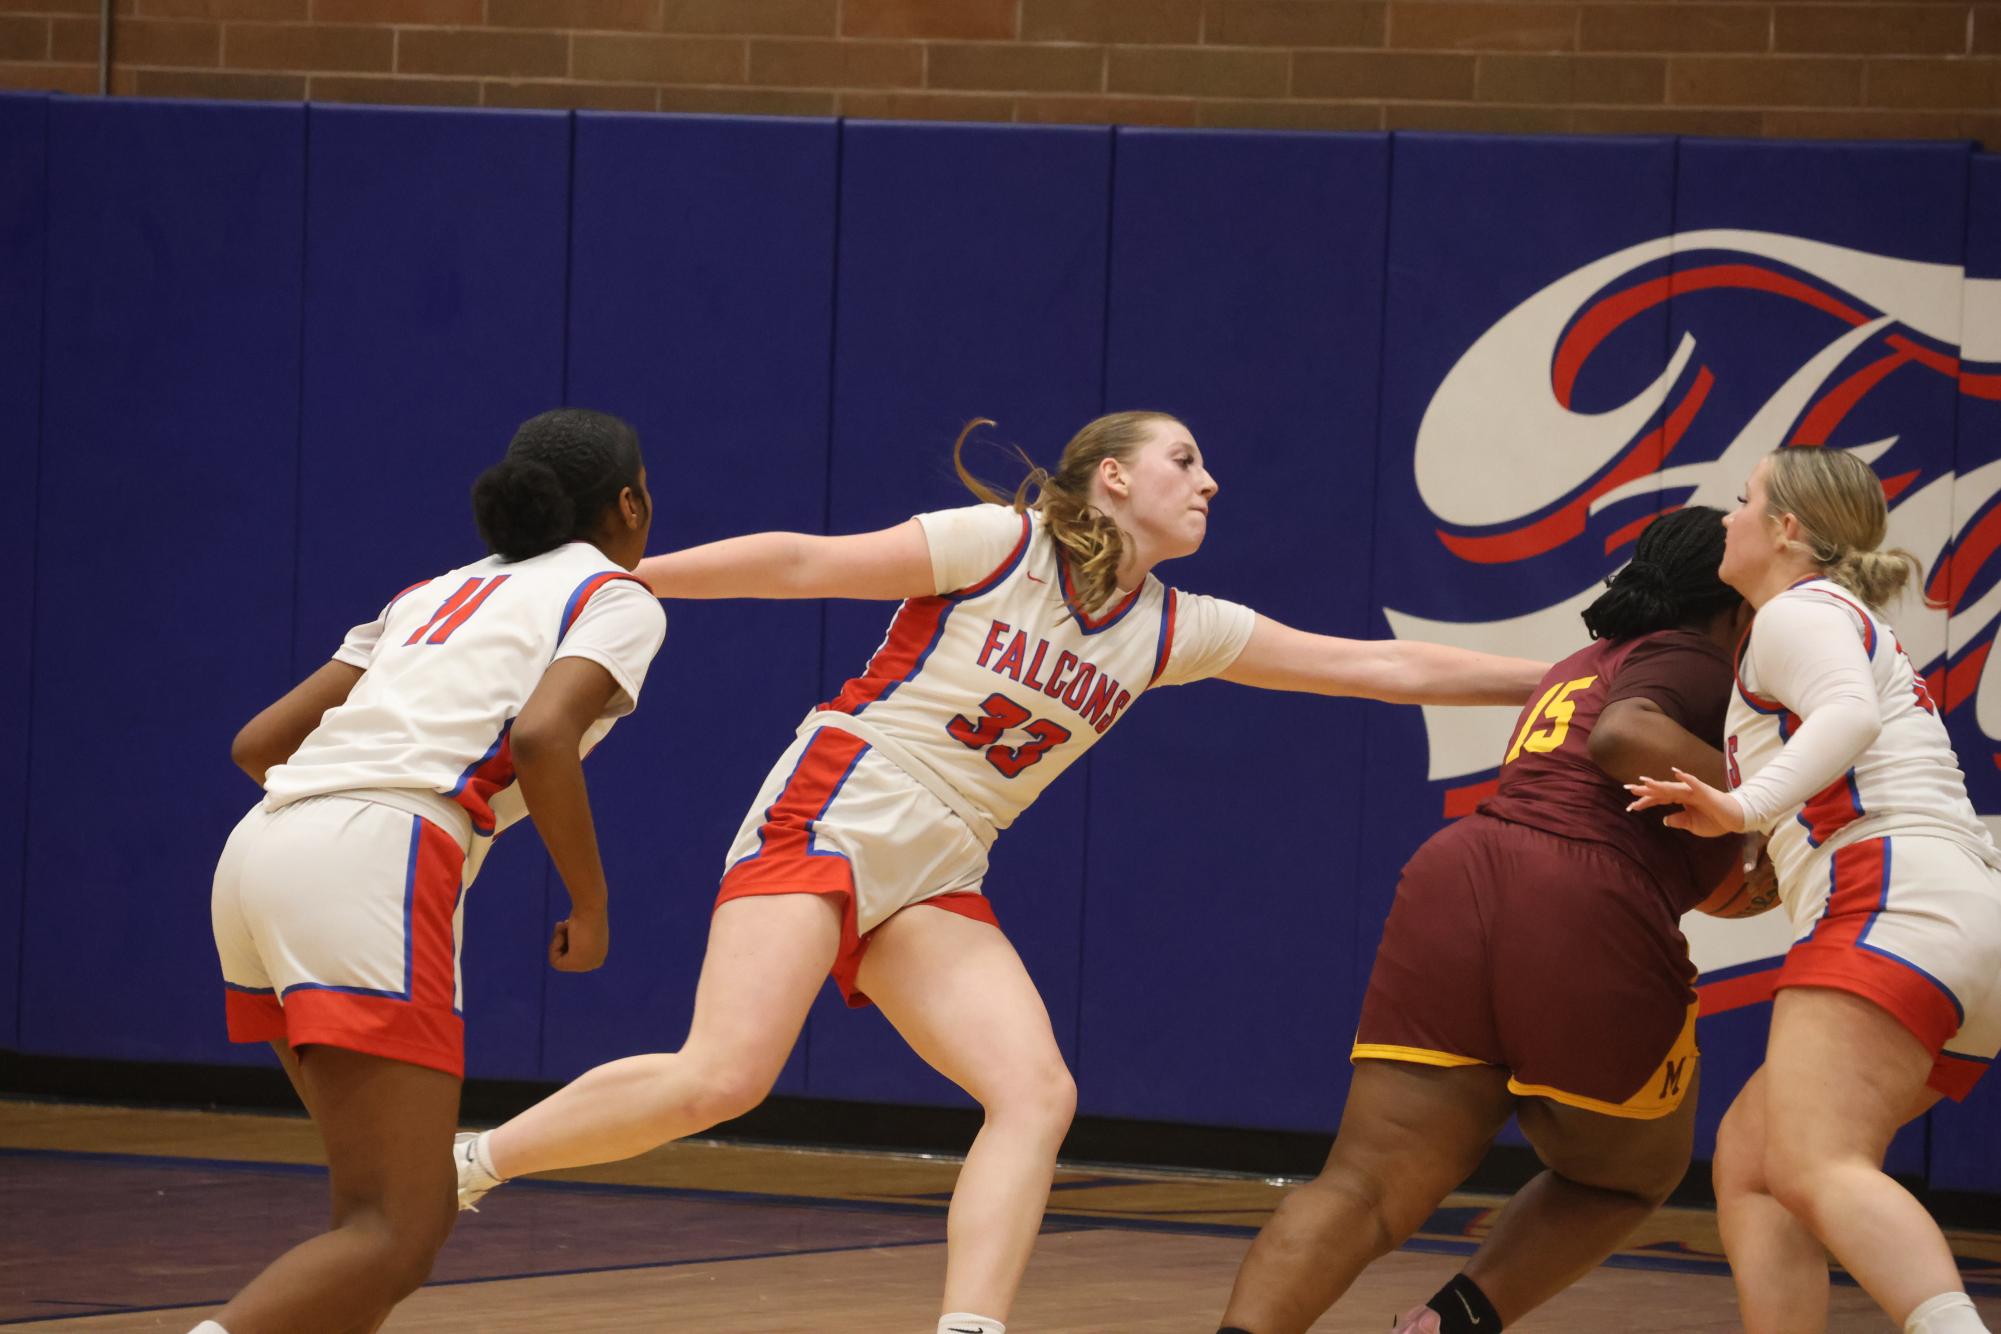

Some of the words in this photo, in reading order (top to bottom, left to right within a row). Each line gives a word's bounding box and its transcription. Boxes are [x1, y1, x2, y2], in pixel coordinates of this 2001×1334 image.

[401, 573, 512, 648] 11
[975, 619, 1132, 735] FALCONS
[1504, 674, 1599, 766] 15
[945, 691, 1073, 780] 33
[1658, 1055, 1687, 1100] M
